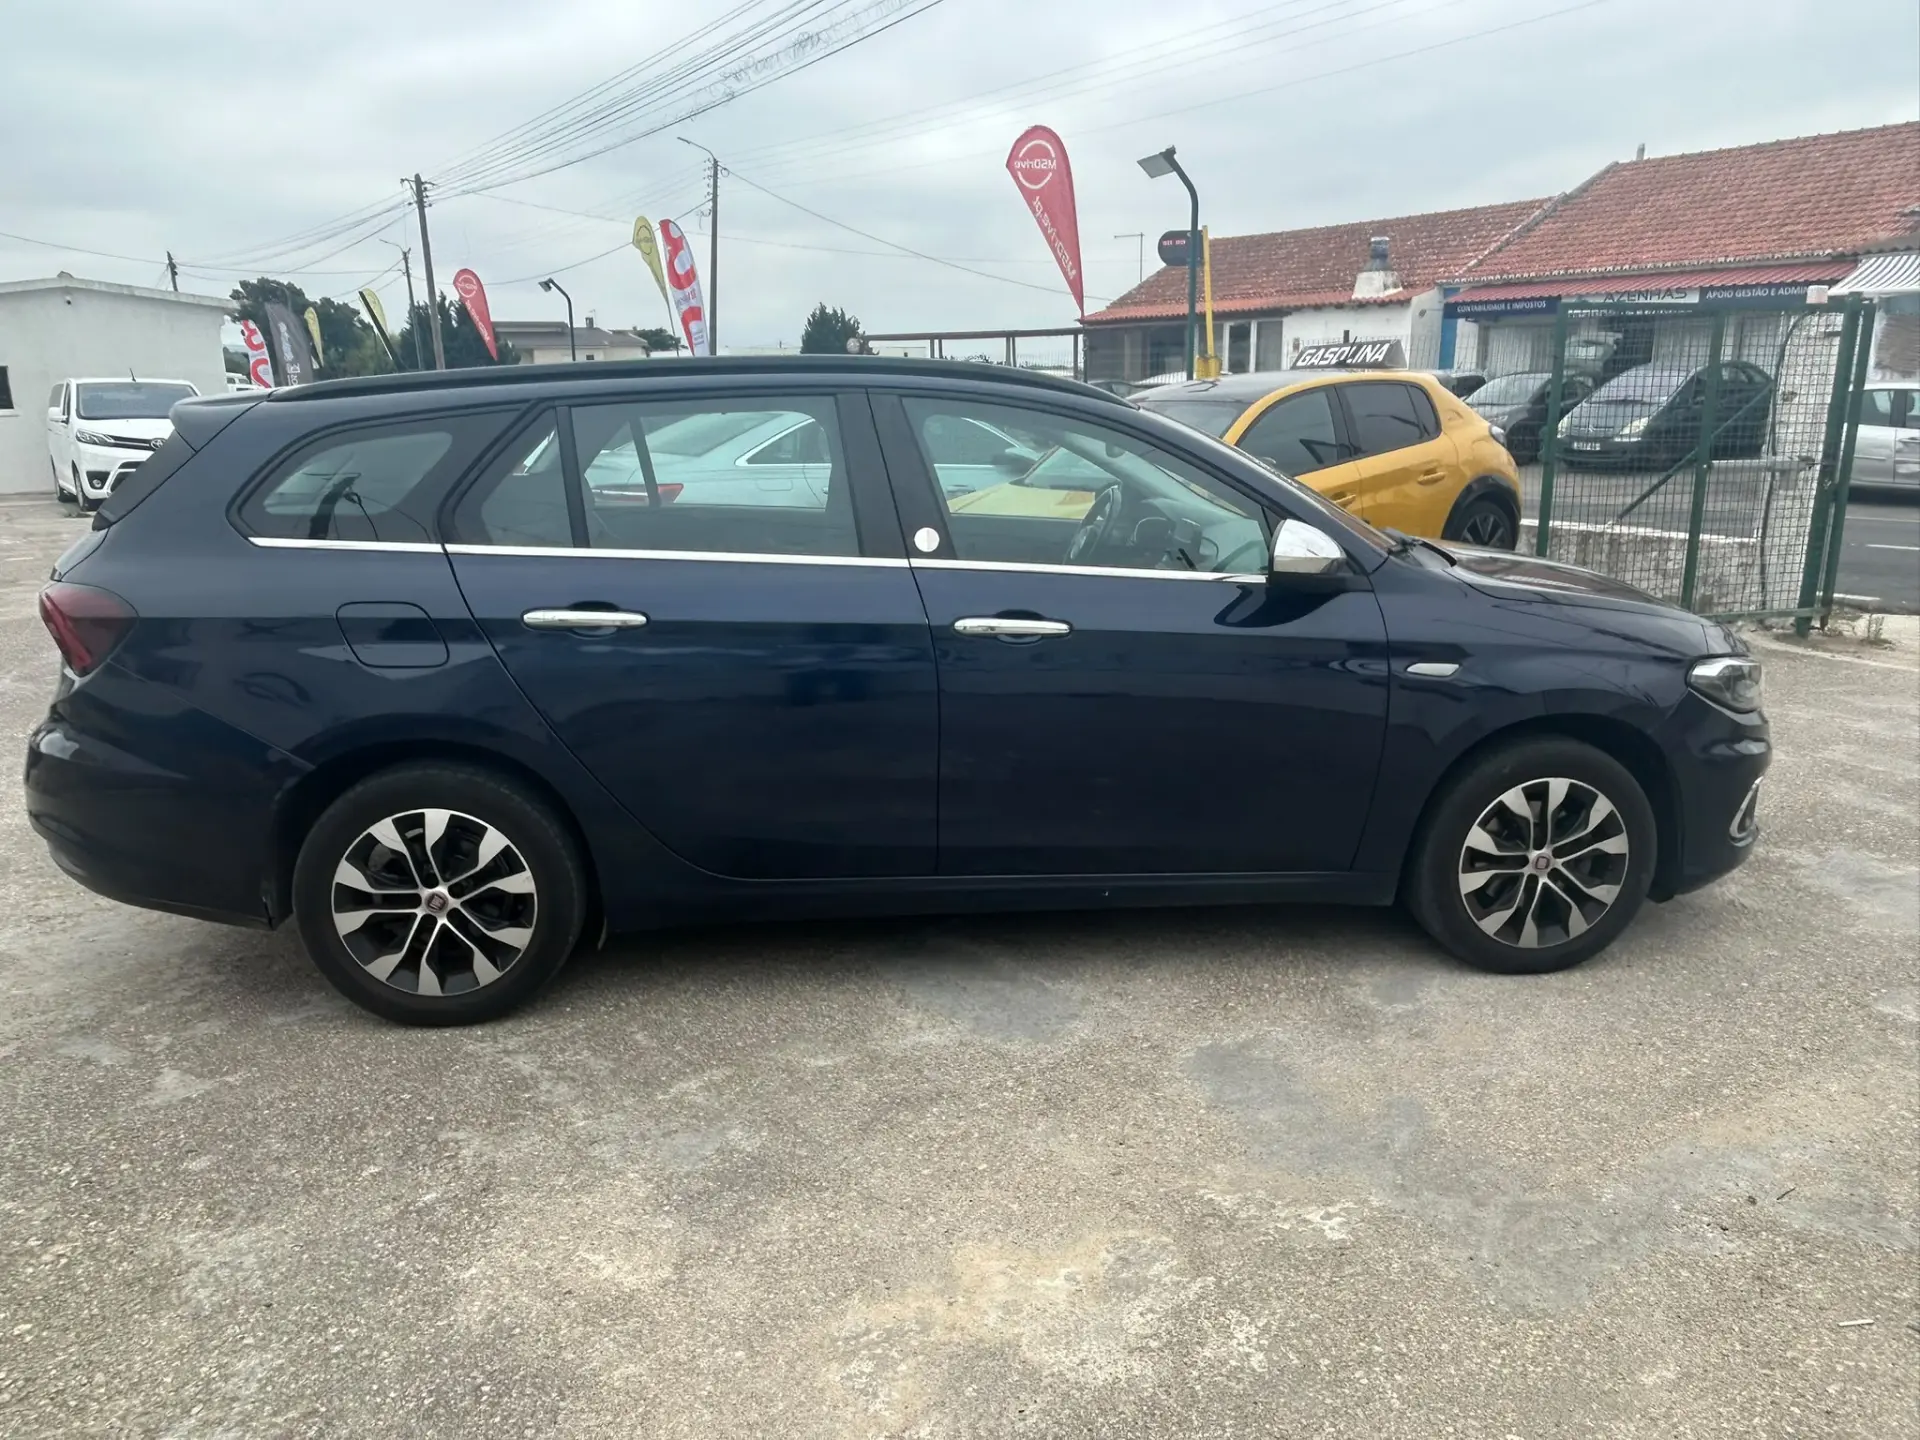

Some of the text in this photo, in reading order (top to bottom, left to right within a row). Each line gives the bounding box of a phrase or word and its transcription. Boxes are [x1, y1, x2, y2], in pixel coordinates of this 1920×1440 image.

[1604, 288, 1686, 303] AZENHAS
[1706, 289, 1733, 299] APOIO
[1735, 287, 1769, 298] GESTÃO
[1457, 302, 1505, 313] CONTABILIDADE
[1512, 300, 1547, 309] IMPOSTOS
[1296, 343, 1391, 367] GASOLINA
